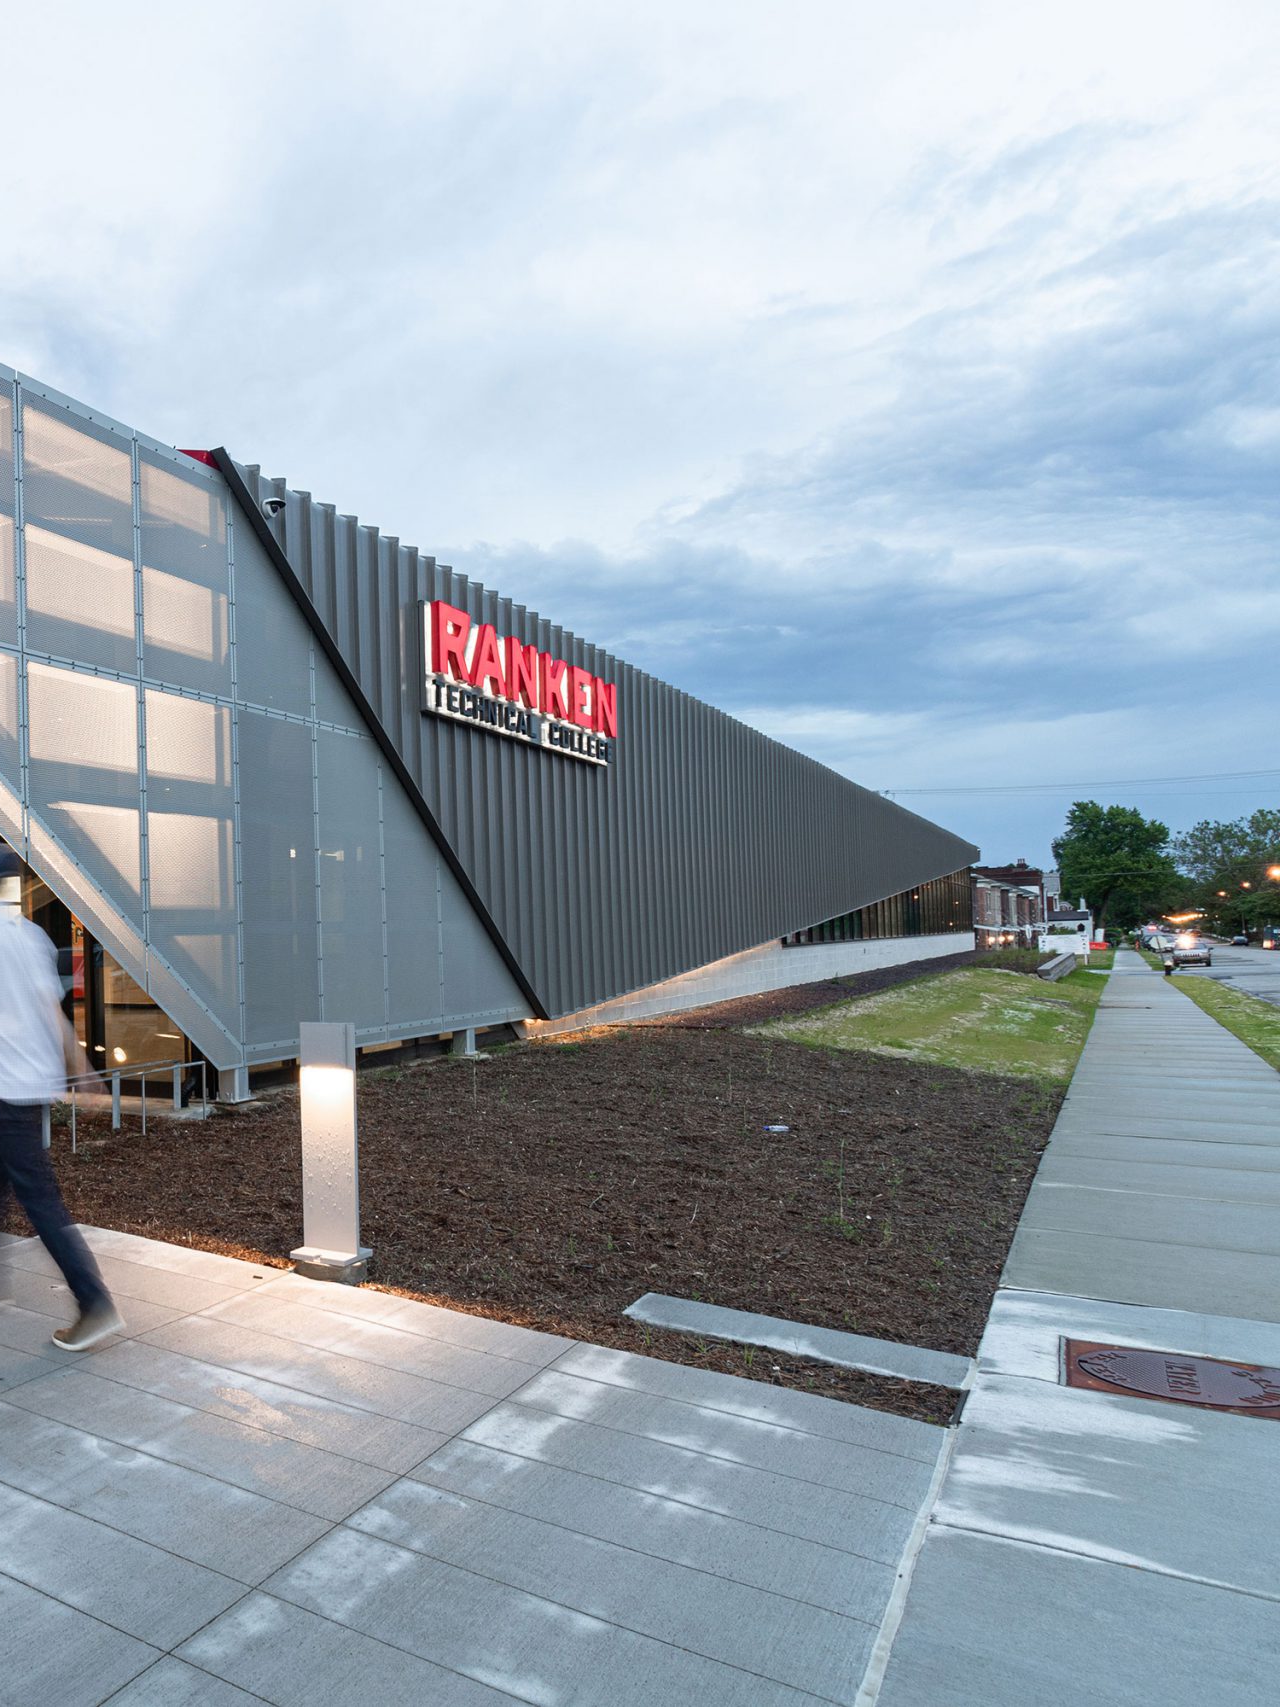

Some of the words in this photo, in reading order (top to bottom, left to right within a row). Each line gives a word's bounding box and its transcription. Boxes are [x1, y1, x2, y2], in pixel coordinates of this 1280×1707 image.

[430, 600, 617, 738] RANKEN
[432, 678, 540, 739] TECHNICAL
[548, 722, 616, 763] COLLEGE
